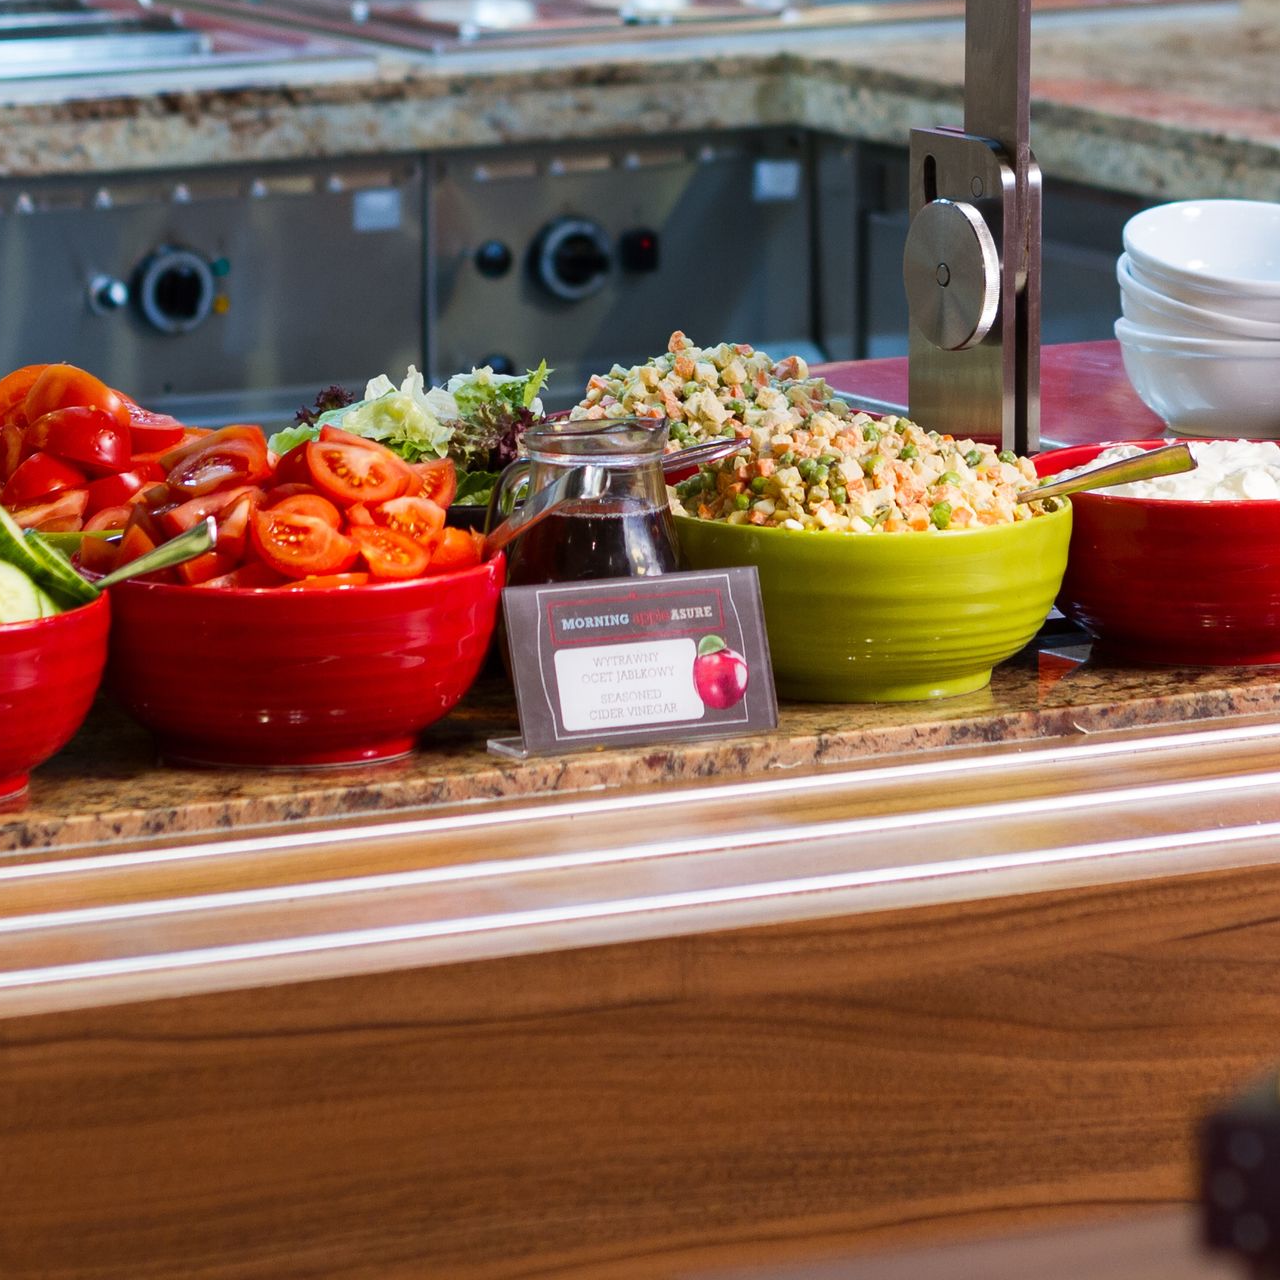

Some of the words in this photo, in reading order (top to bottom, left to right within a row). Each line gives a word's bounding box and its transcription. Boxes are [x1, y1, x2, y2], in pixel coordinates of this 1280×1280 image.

[562, 614, 629, 630] MORNING
[593, 652, 659, 667] WYTRAWNY
[581, 672, 614, 684] OCET
[616, 665, 675, 683] JABŁKOWY
[600, 689, 662, 704] SEASONED
[589, 708, 625, 721] CIDER
[626, 702, 678, 718] VINEGAR
